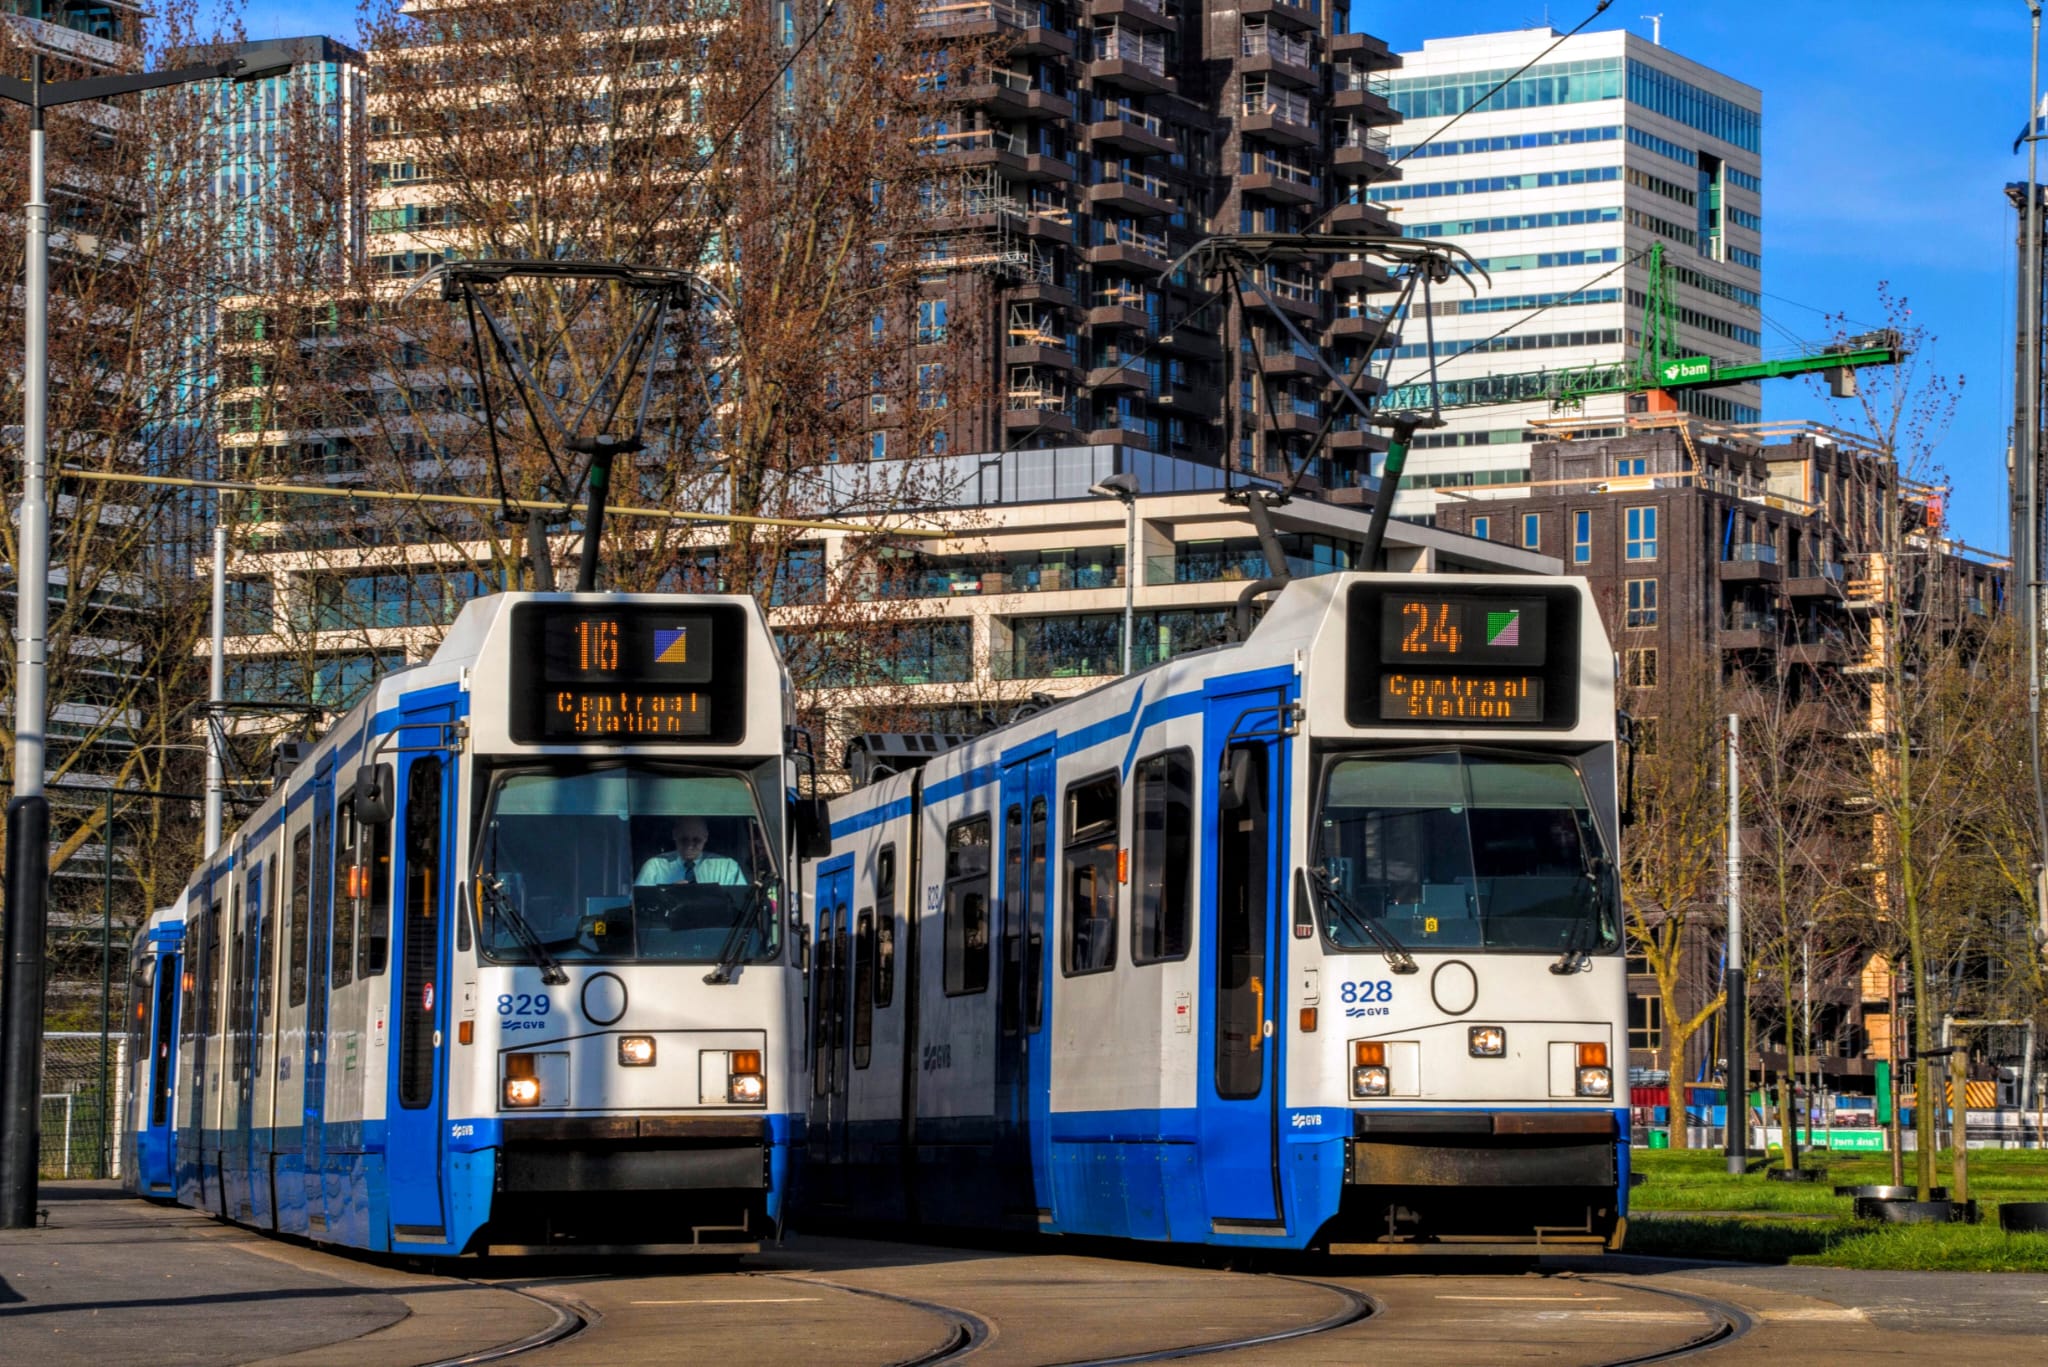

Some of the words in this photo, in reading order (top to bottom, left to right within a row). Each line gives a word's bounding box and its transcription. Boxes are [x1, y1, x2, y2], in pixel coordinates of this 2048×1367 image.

[1681, 363, 1708, 377] bam
[1402, 603, 1462, 652] 24
[574, 622, 618, 670] 16
[1389, 674, 1528, 697] Centraal
[558, 692, 698, 713] Centraal
[1407, 696, 1511, 717] Station
[575, 712, 681, 732] Station
[1341, 980, 1393, 1003] 828
[497, 993, 551, 1016] 829
[1367, 1007, 1390, 1016] GVB
[522, 1021, 546, 1030] GVB
[1305, 1114, 1322, 1126] GVB
